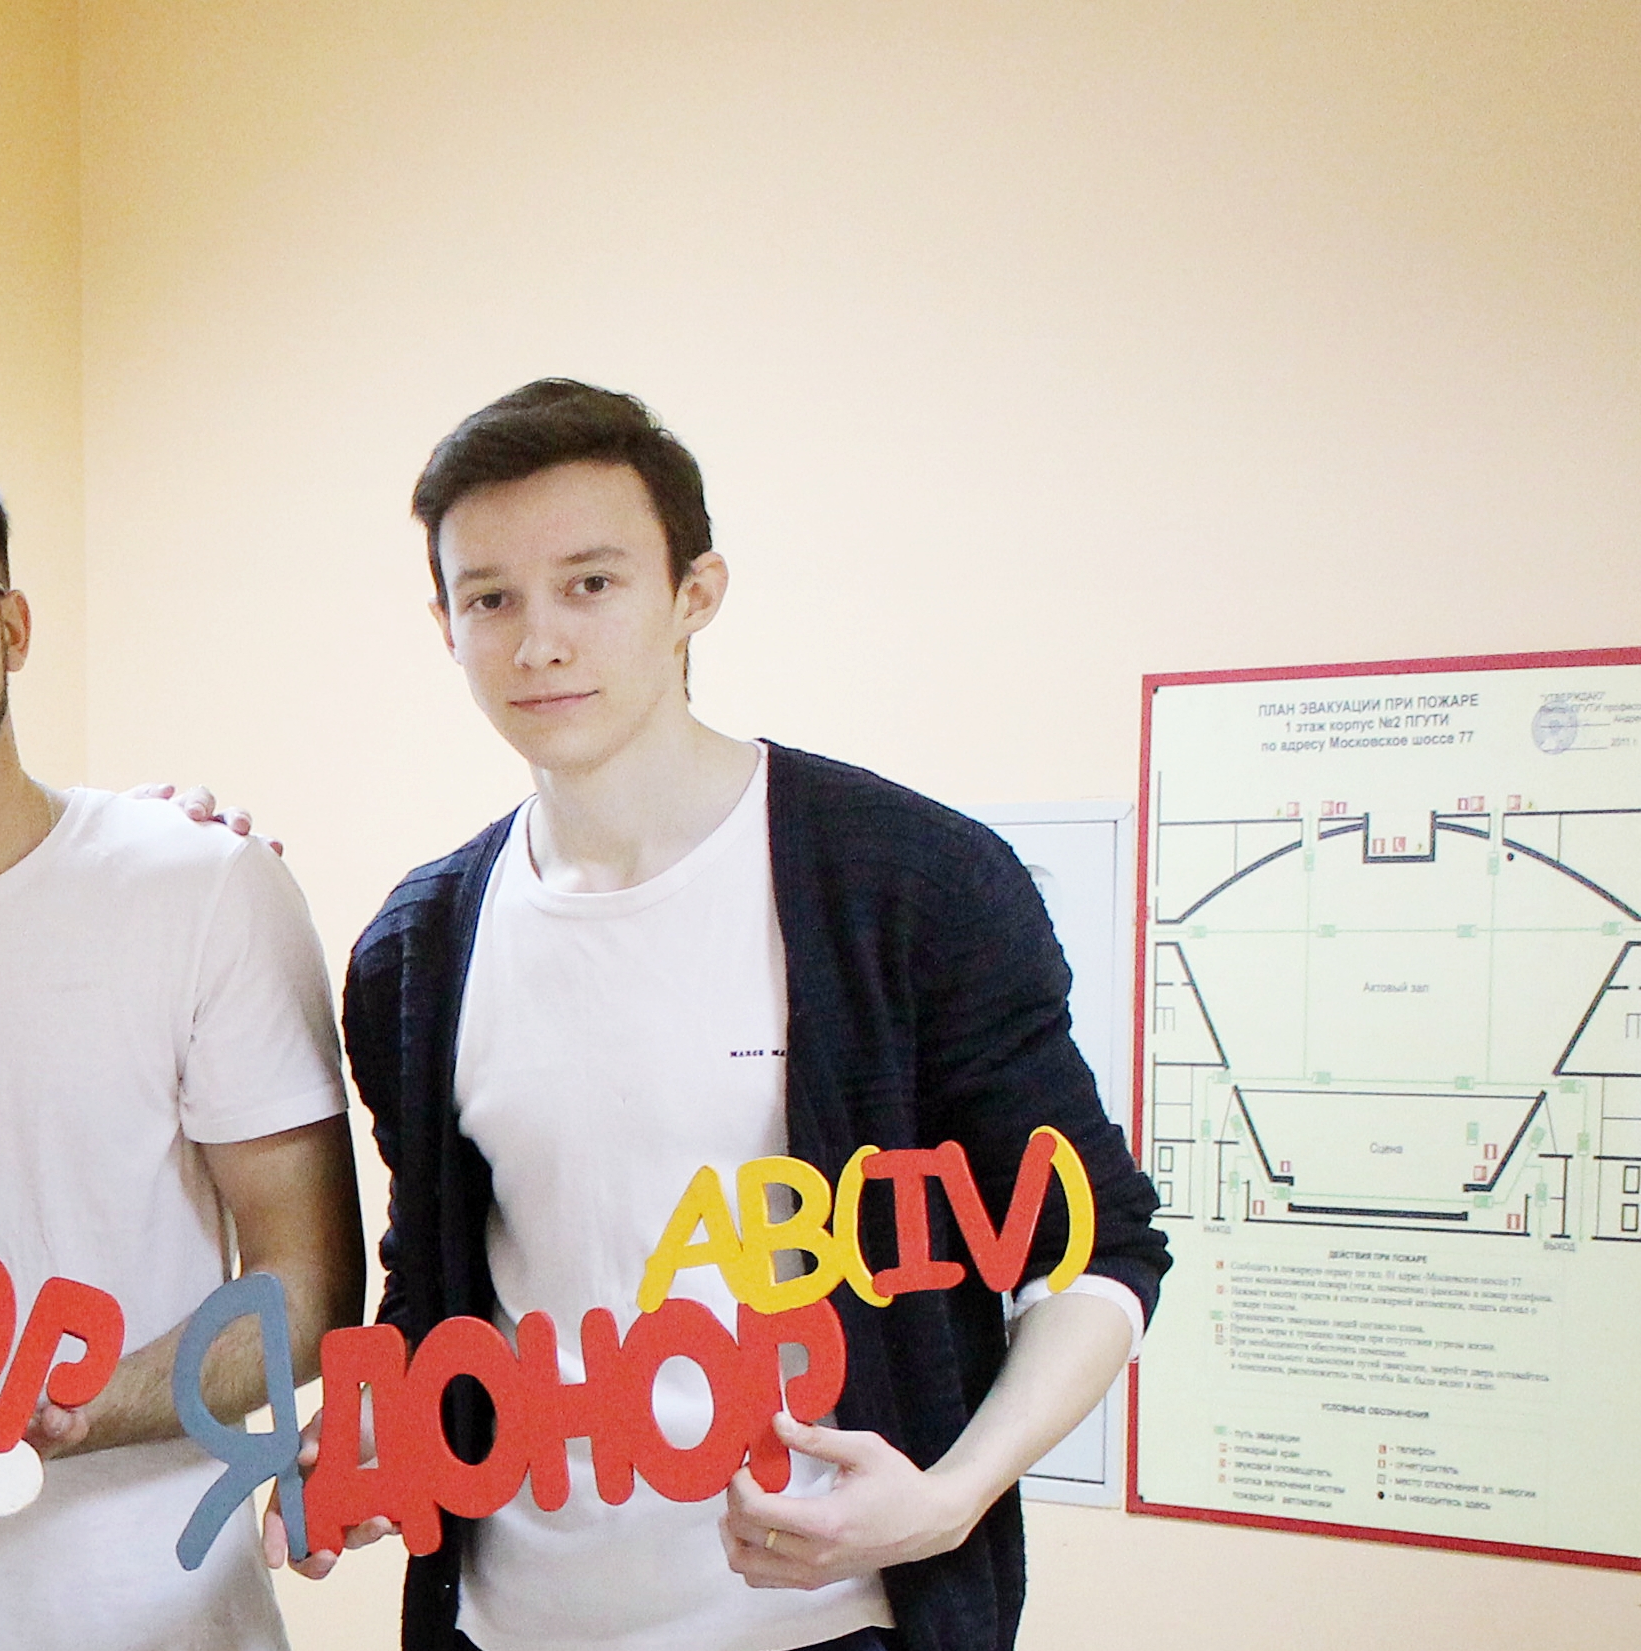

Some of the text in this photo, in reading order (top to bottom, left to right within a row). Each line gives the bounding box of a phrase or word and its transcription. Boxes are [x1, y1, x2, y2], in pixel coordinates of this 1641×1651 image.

[1258, 693, 1480, 717] ПЛАН ЭВАКУАЦИИ ПРИ ПОЖАРЕ
[1285, 713, 1450, 735] 1 этаж корпус №2 ПГУТИ
[1261, 730, 1475, 753] по адресу Московское шоссе 77
